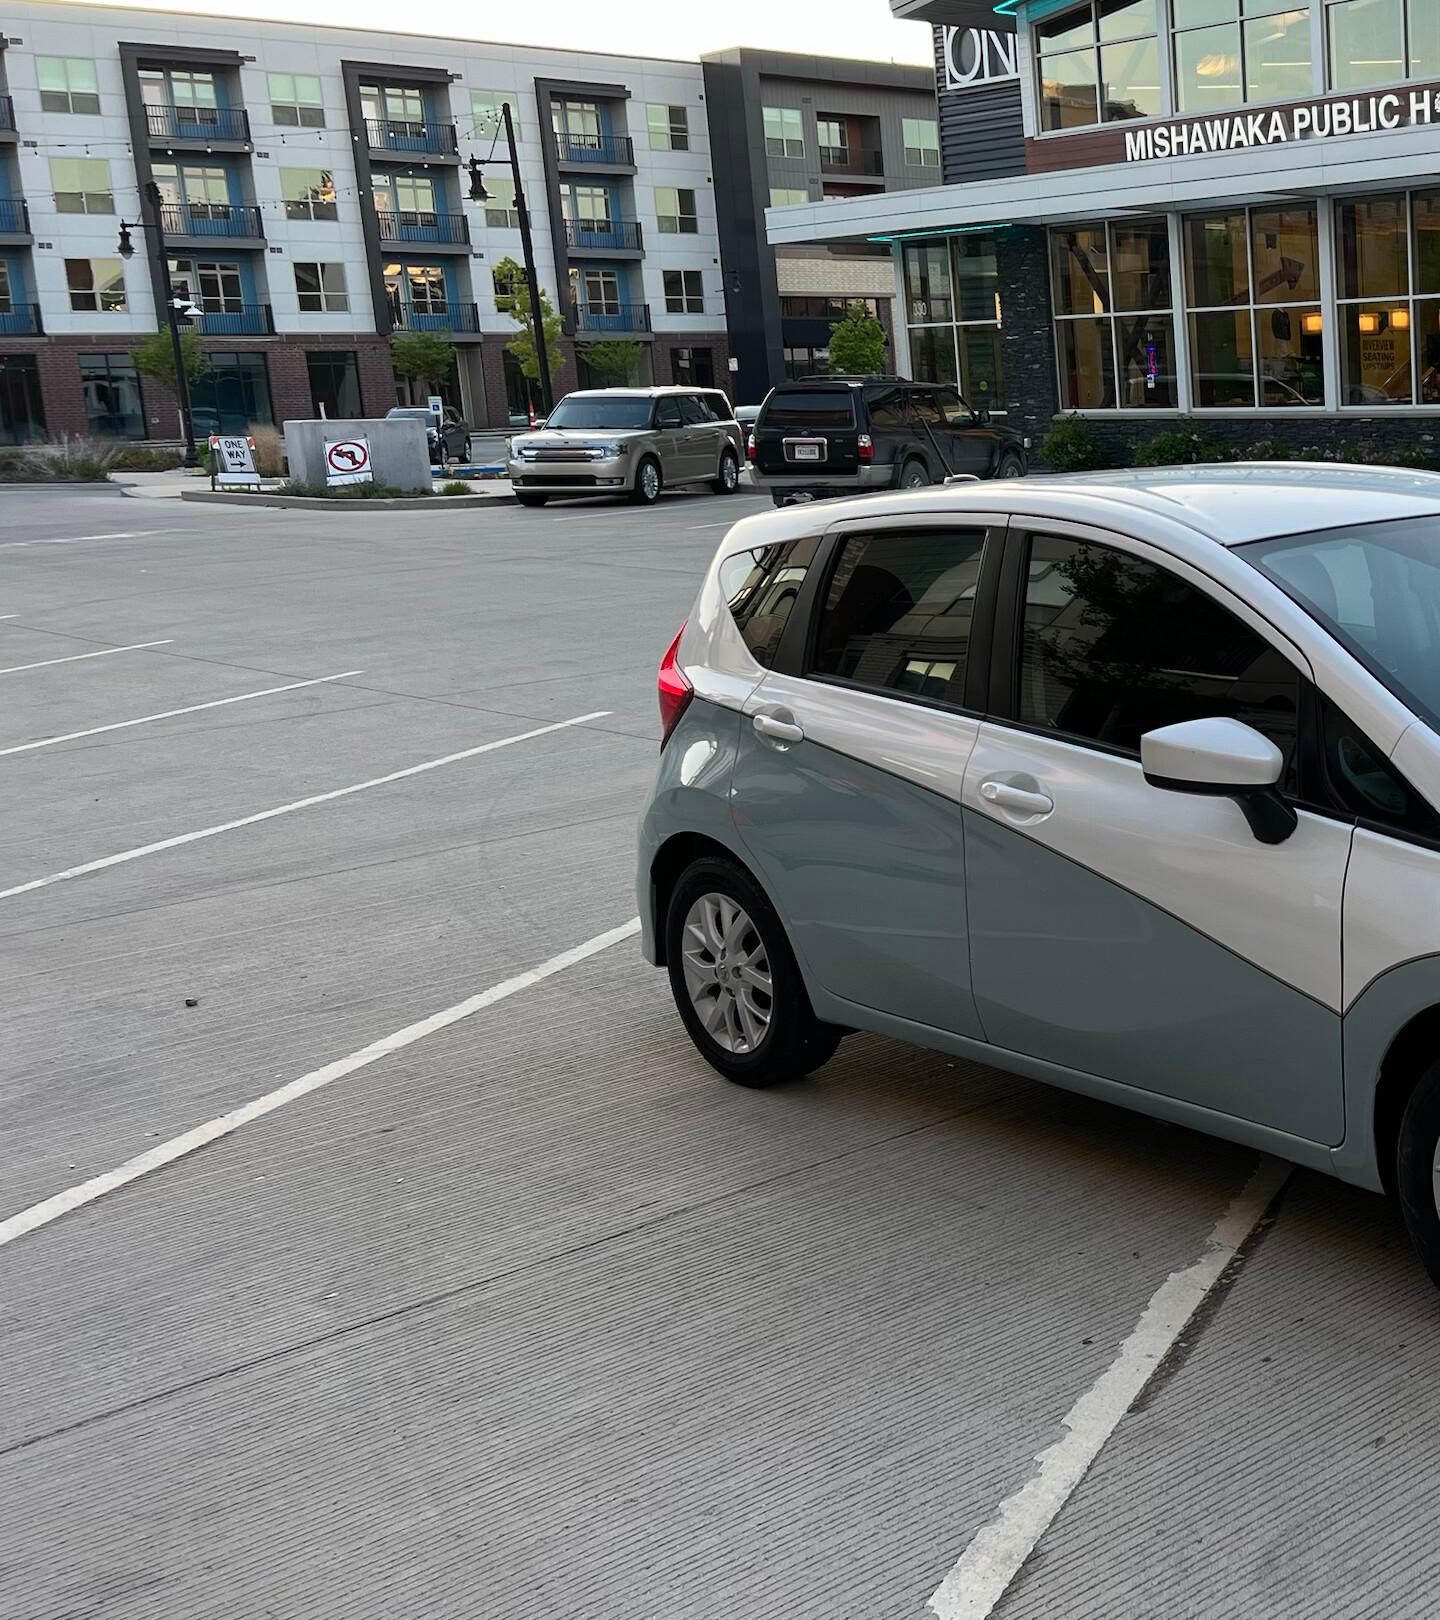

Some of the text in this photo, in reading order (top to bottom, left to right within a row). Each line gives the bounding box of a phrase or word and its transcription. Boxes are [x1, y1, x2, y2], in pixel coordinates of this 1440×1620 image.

[1125, 111, 1287, 161] MISHAWAKA
[1293, 94, 1400, 140] PUBLIC
[1362, 351, 1395, 361] SEATING
[224, 440, 244, 449] ONE
[226, 450, 247, 459] WAY
